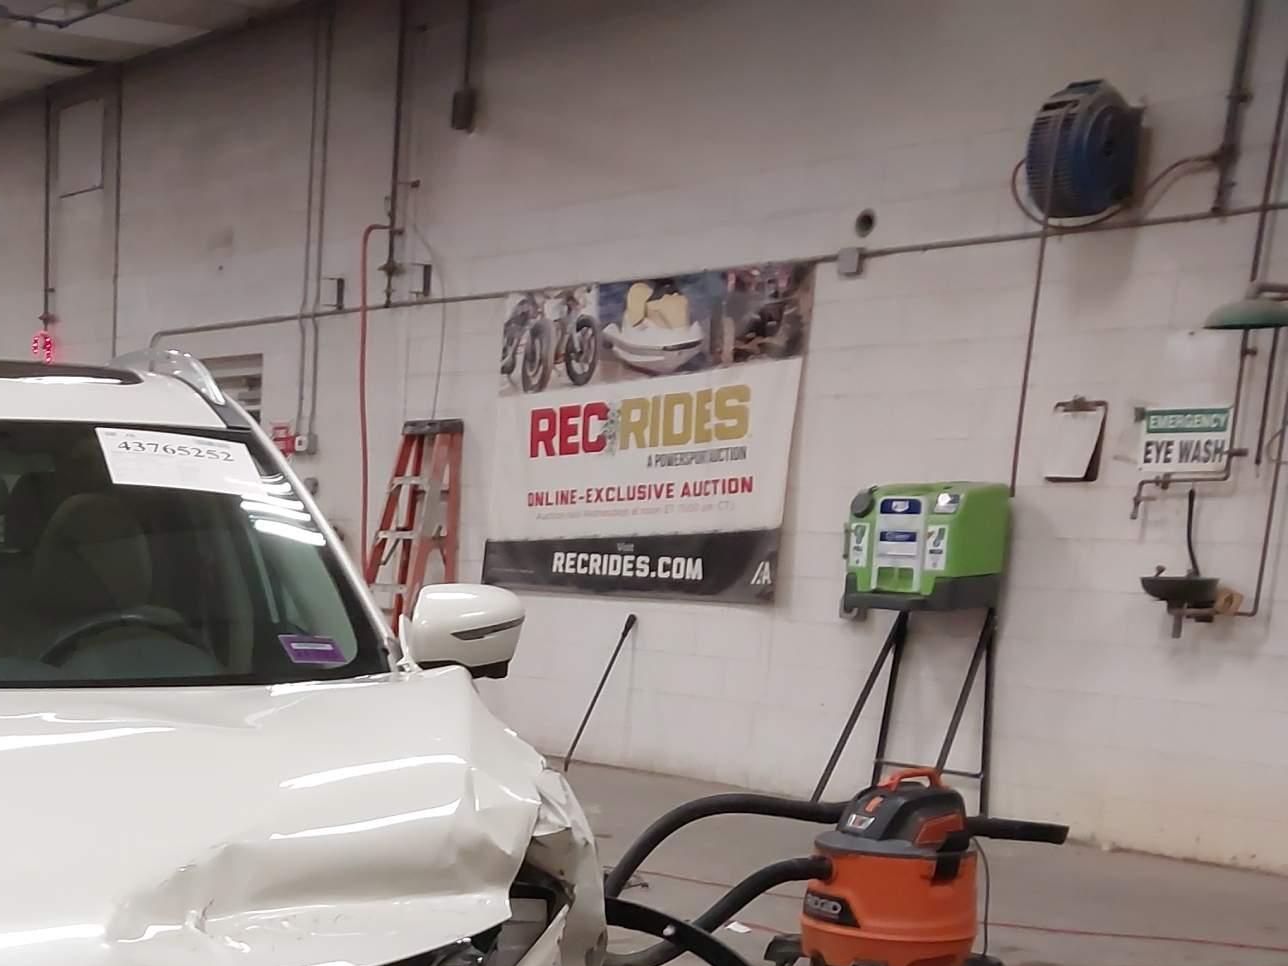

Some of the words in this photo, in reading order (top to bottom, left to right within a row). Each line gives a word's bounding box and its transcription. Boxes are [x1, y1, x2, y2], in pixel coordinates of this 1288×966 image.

[530, 402, 609, 458] REC
[619, 384, 751, 450] RIDES
[117, 440, 235, 462] 43765252
[1143, 440, 1174, 463] EYE
[1178, 439, 1225, 463] WASH
[528, 482, 674, 507] ONLINE-EXCLUSIVE
[680, 476, 754, 498] AUCTION
[552, 552, 703, 580] RECRIDES.COM
